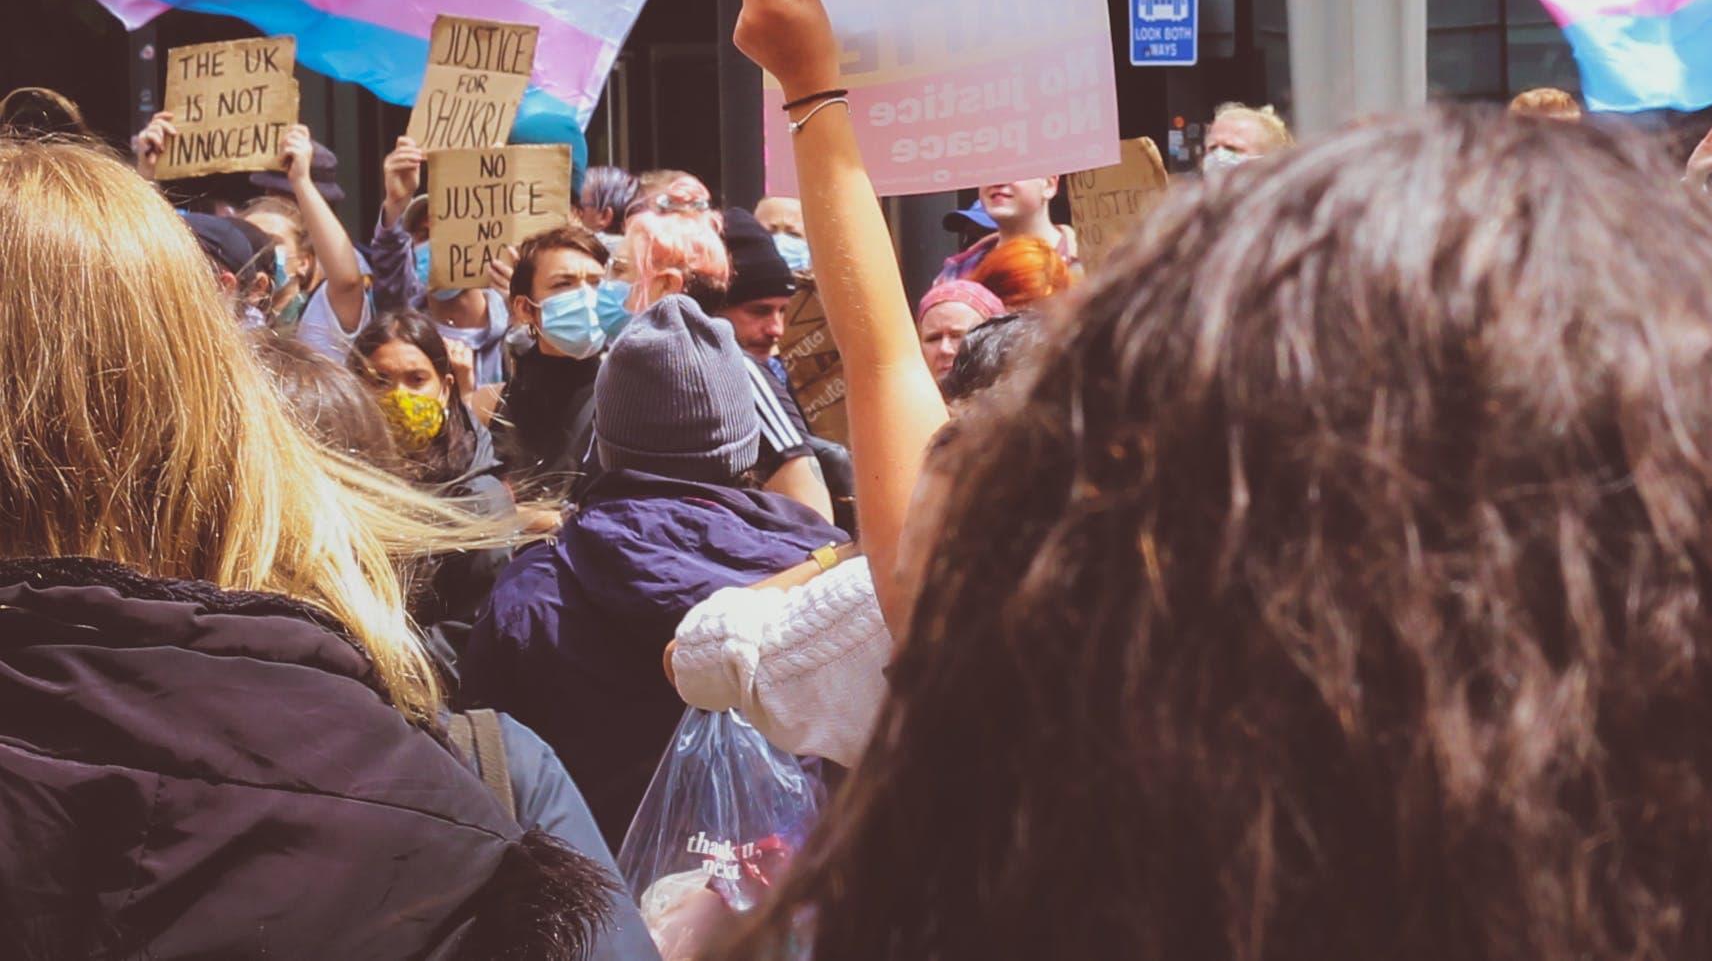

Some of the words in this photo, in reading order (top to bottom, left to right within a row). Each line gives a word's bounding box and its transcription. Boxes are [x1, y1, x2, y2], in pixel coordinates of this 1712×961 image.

[437, 22, 532, 75] JUSTICE
[1135, 26, 1162, 41] LOOK
[1164, 26, 1193, 41] BOTH
[178, 49, 226, 80] THE
[243, 46, 280, 74] UK
[1145, 43, 1177, 57] WAYS
[456, 74, 489, 94] FOR
[184, 93, 204, 123] IS
[217, 84, 269, 117] NOT
[418, 89, 507, 149] SHUKRI
[168, 122, 288, 167] INNOCENT
[479, 152, 506, 179] NO
[437, 180, 549, 221] JUSTICE
[476, 220, 503, 242] NO
[686, 831, 740, 861] thank
[701, 858, 741, 880] next
